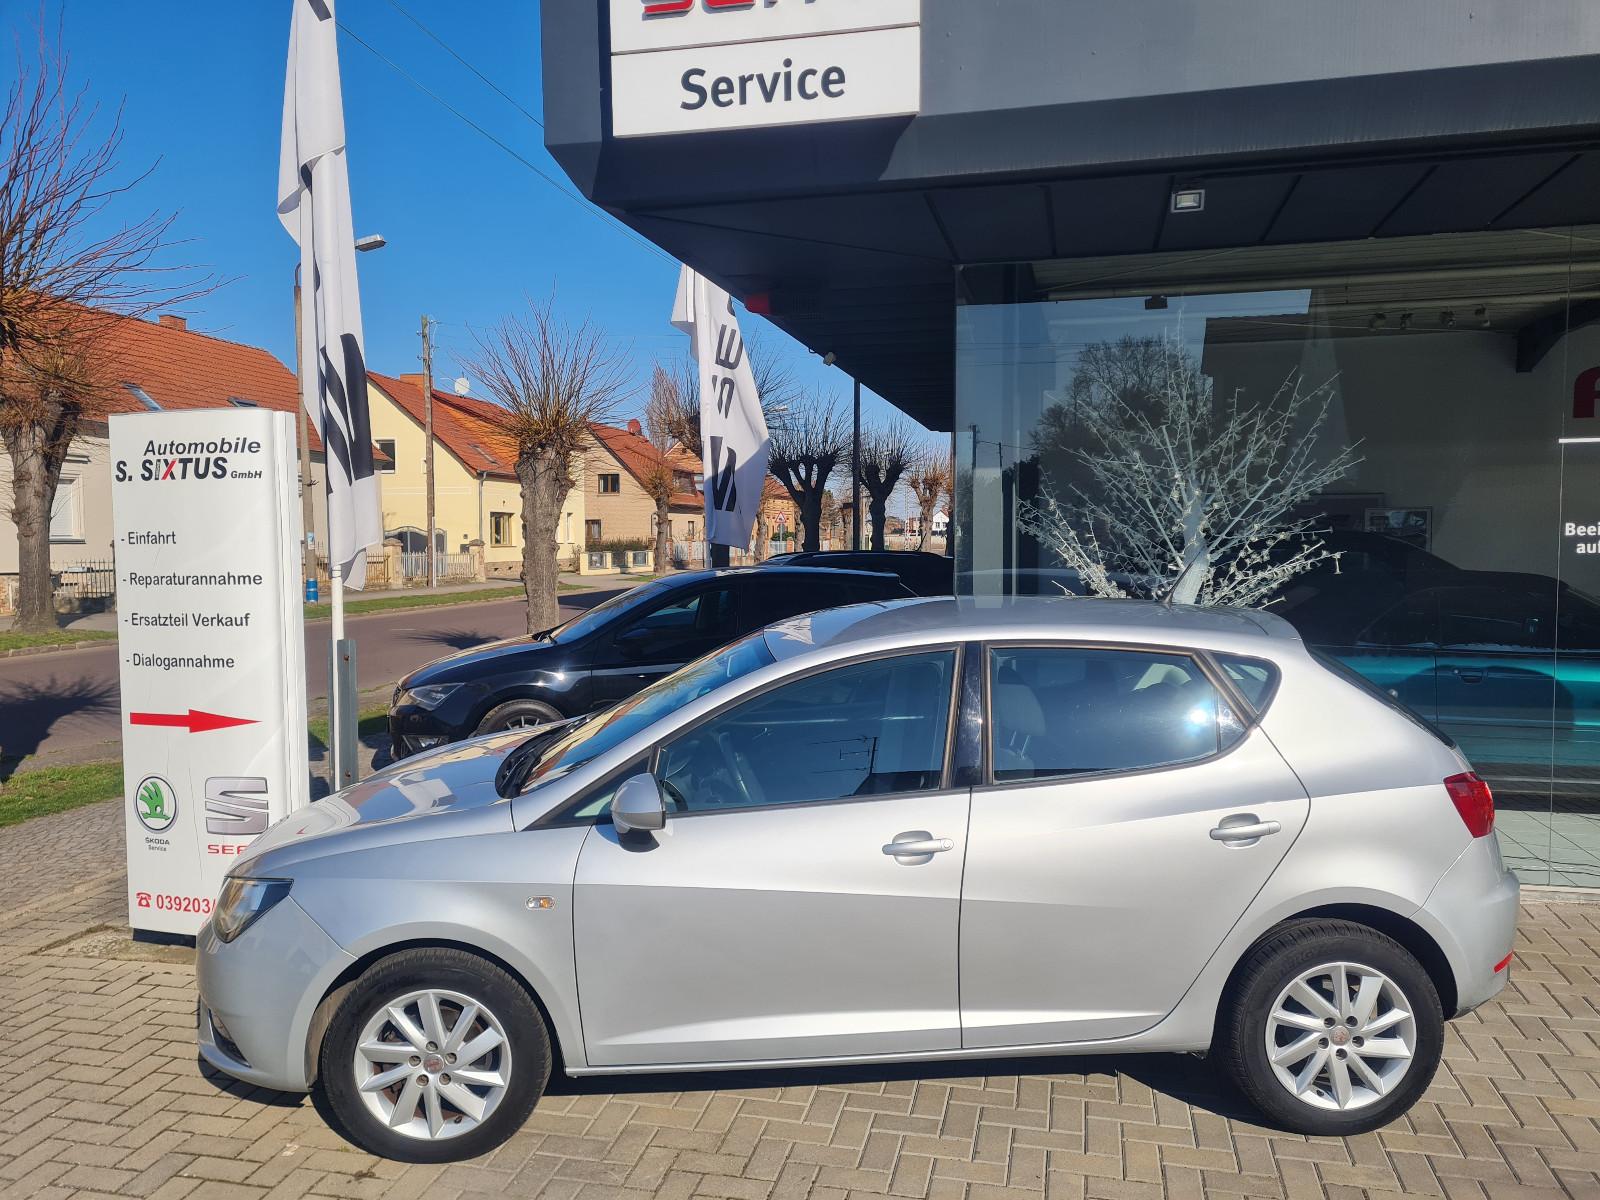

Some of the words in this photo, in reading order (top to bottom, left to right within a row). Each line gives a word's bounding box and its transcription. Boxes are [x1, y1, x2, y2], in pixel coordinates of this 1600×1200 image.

[680, 57, 846, 111] Service
[144, 437, 261, 456] Automobile
[115, 460, 133, 483] S.
[230, 470, 262, 479] GmbH
[128, 531, 176, 545] Einfahrt
[129, 571, 263, 588] Reparaturannahme
[131, 612, 188, 627] Ersatzteil
[192, 612, 250, 627] Verkauf
[133, 653, 235, 671] Dialogannahme
